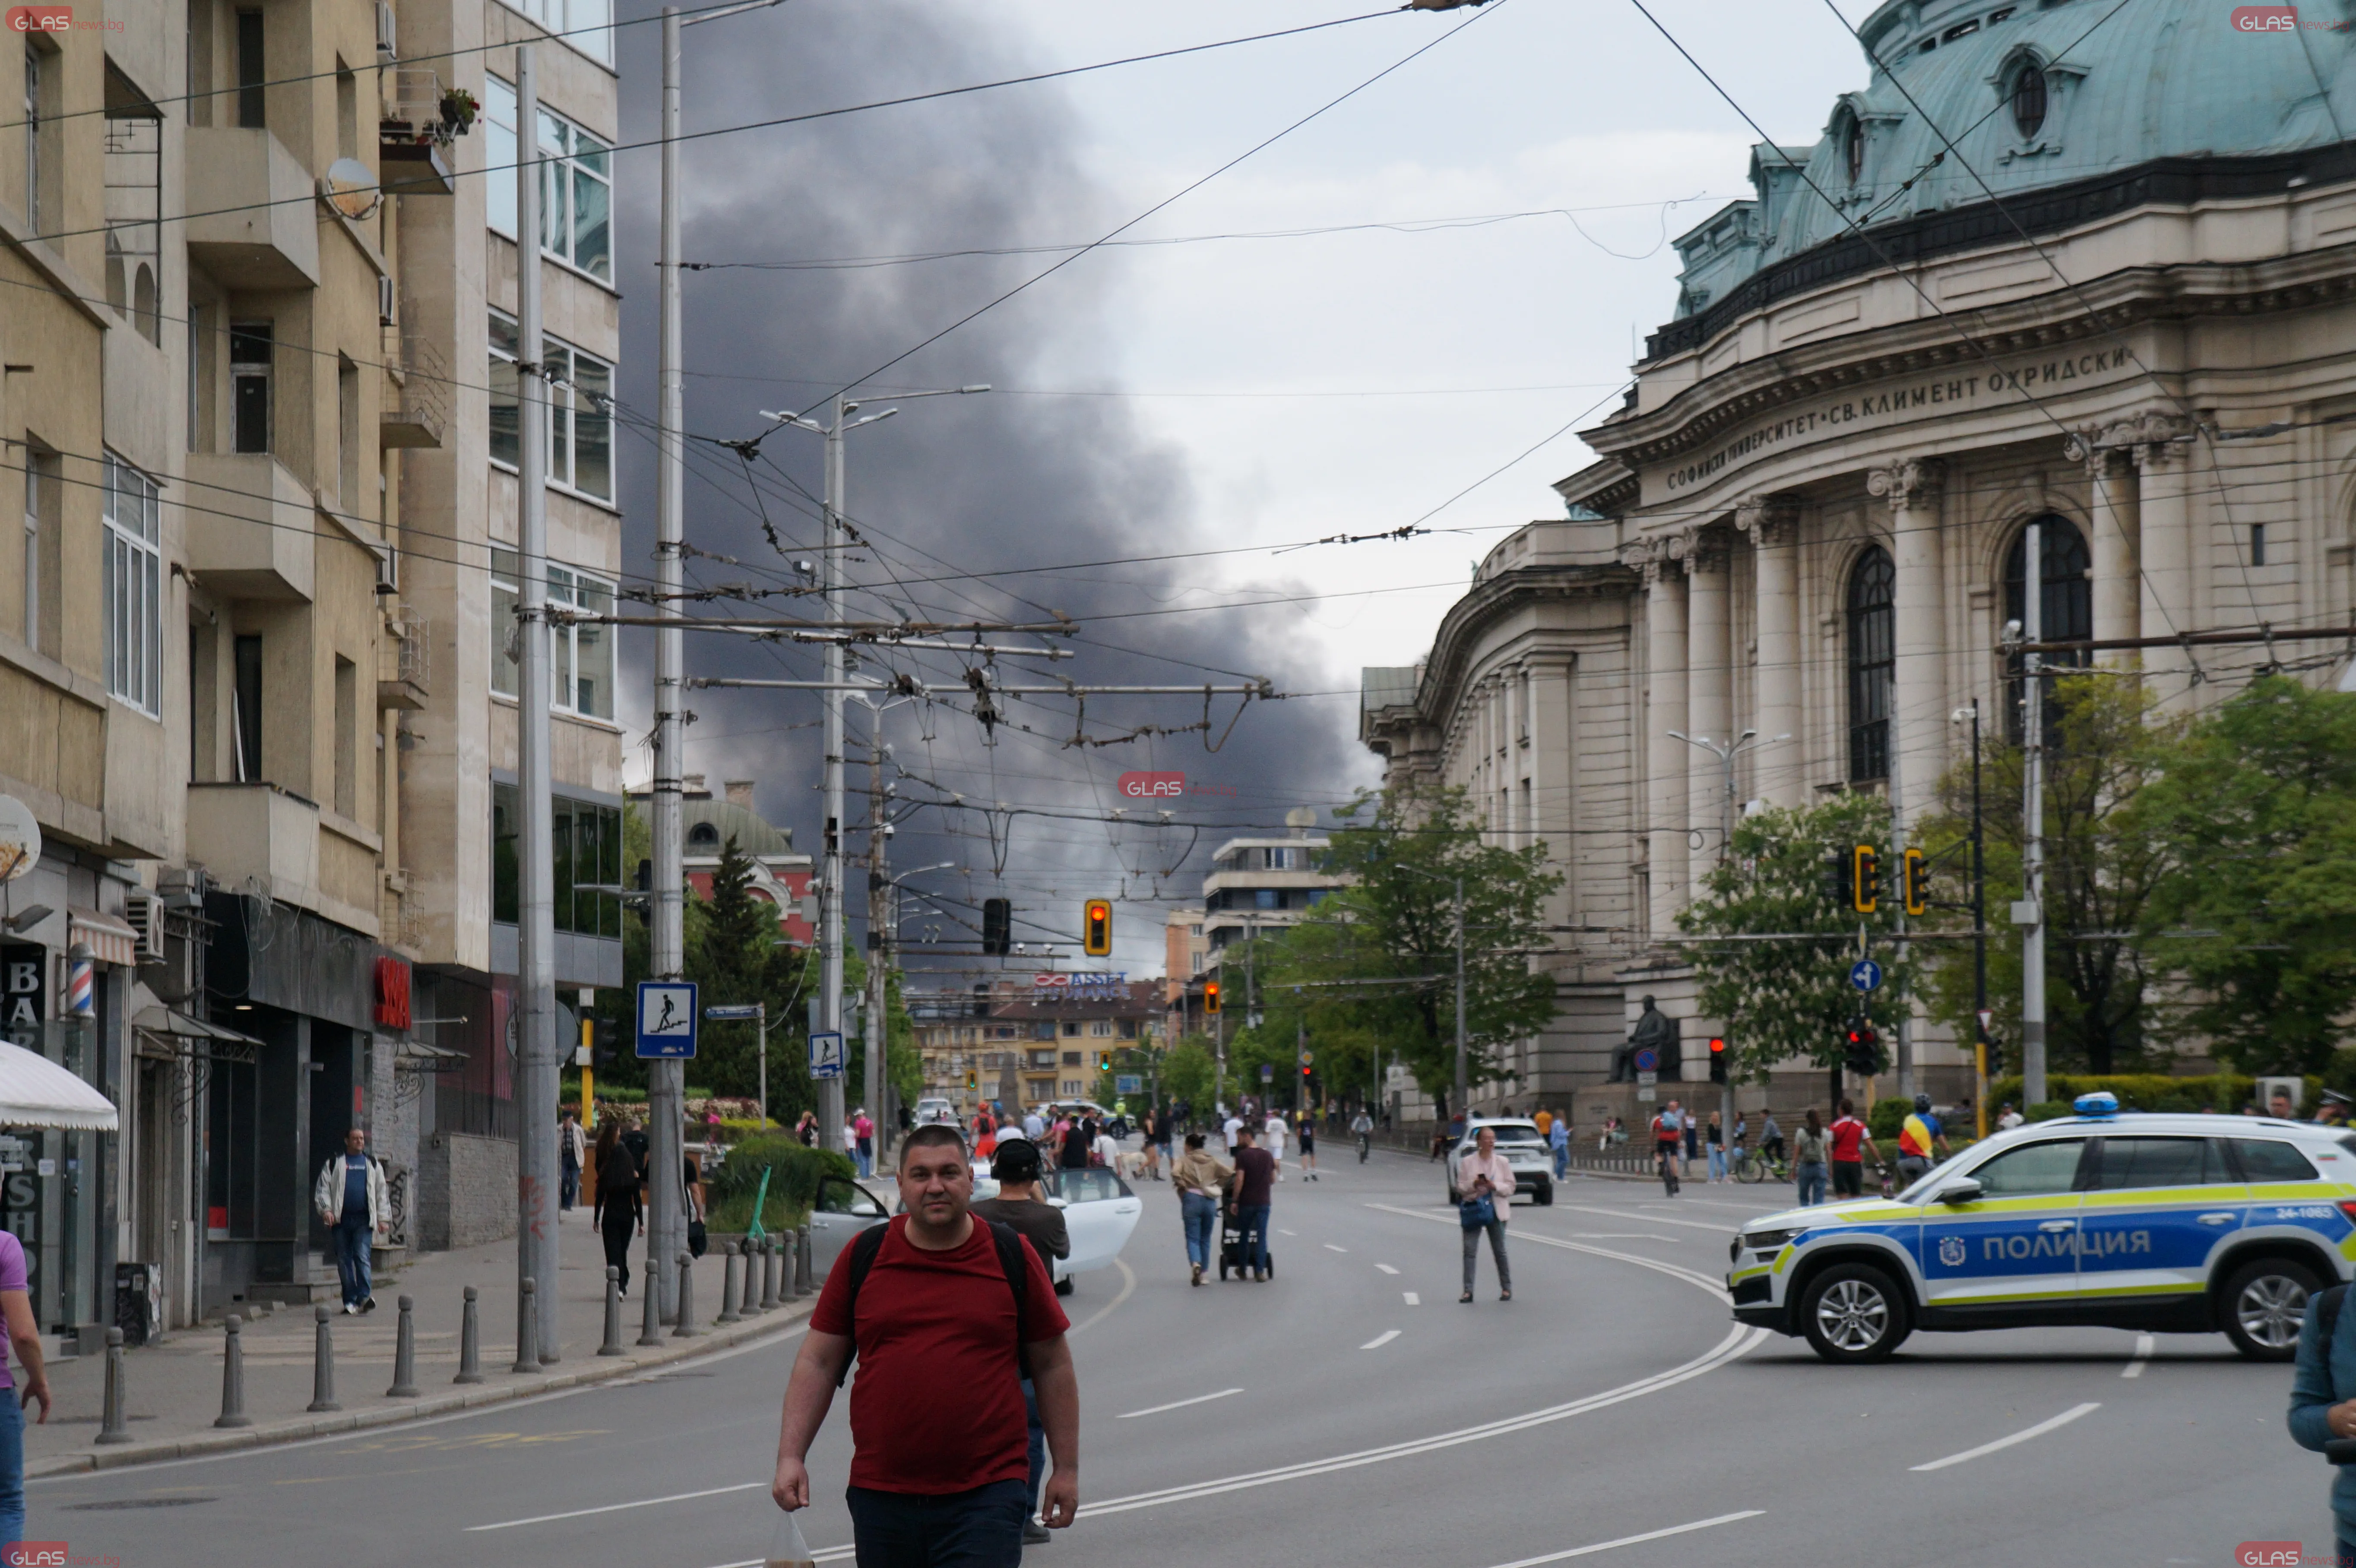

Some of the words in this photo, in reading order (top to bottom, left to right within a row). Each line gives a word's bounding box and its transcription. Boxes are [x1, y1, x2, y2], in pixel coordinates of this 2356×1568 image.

[1862, 378, 1979, 416] КЛИМЕНТ
[1989, 348, 2125, 392] ОХРИДСКИ
[1984, 1230, 2151, 1260] ПОЛИЦИЯ
